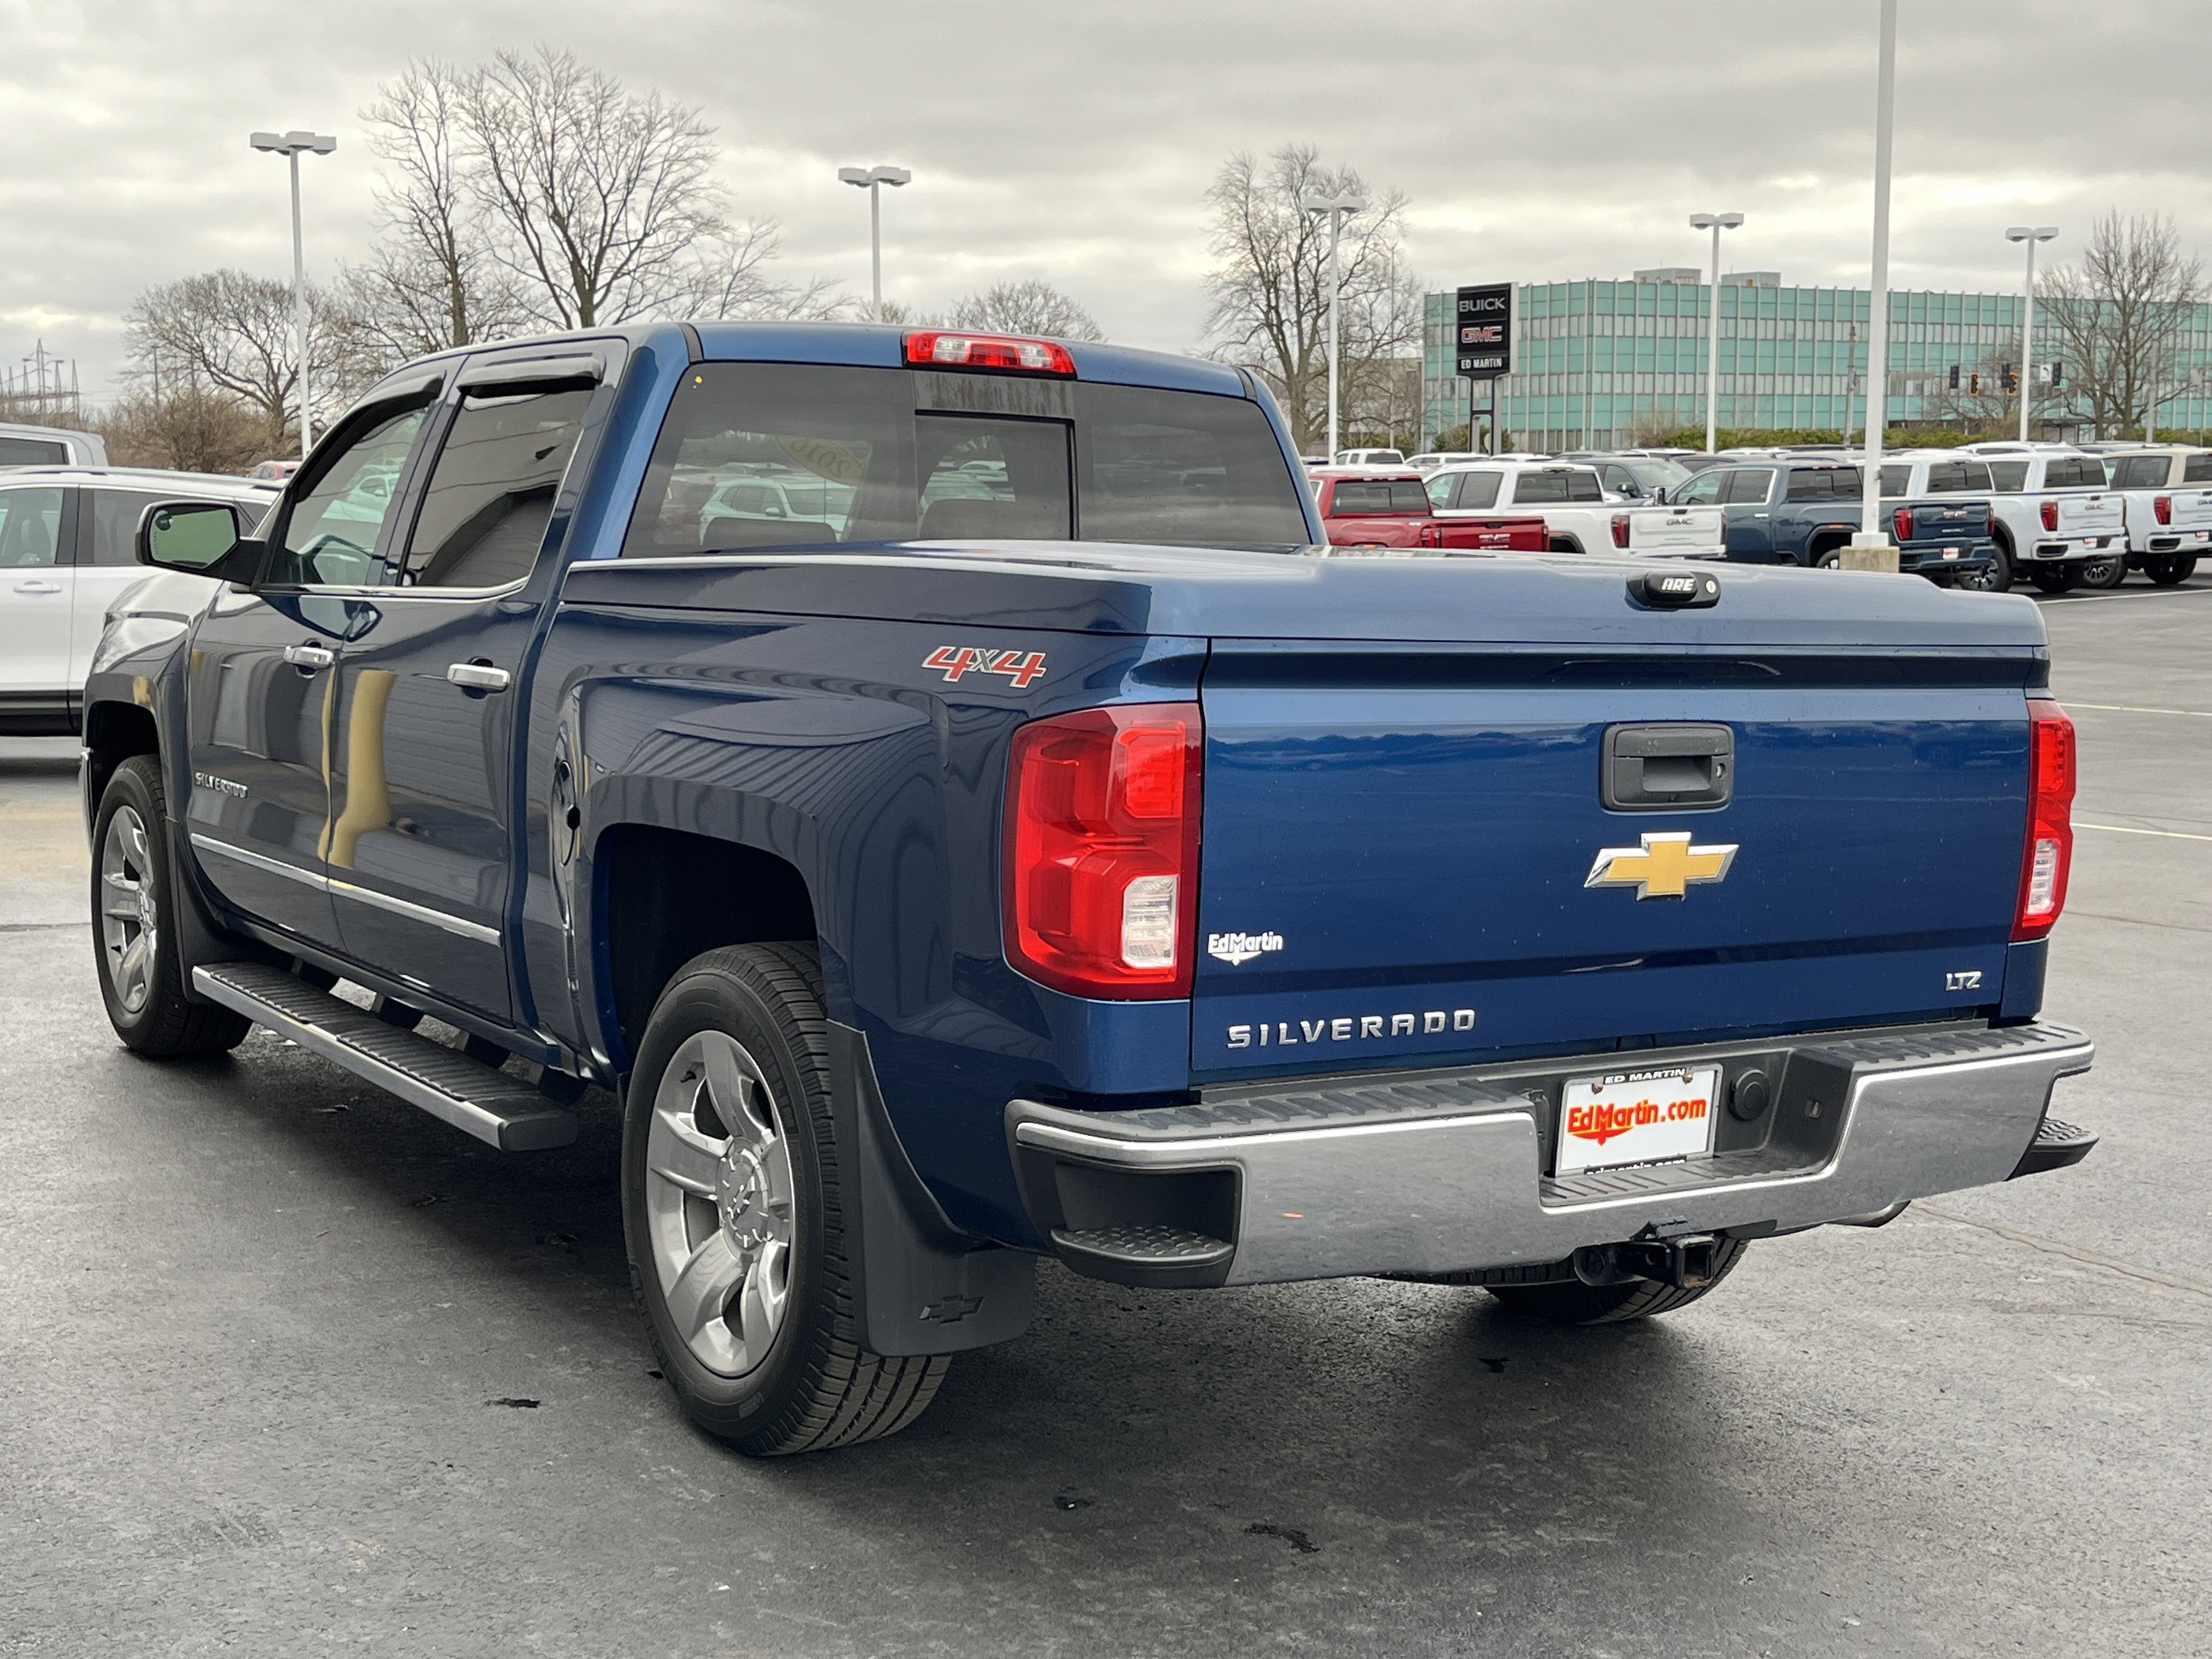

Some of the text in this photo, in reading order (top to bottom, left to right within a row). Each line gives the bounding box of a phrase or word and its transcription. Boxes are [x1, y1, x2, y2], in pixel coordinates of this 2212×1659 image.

[1459, 297, 1505, 312] BUICK
[1462, 325, 1503, 343] GMC
[1461, 358, 1502, 369] ED MARTIN
[1661, 577, 1695, 591] ARE
[1208, 932, 1283, 954] EdMartin
[1945, 971, 1982, 991] LTZ
[1227, 1009, 1475, 1048] SILVERADO
[1604, 1068, 1686, 1084] ED MARTIN
[1567, 1099, 1706, 1133] EdMartin.com
